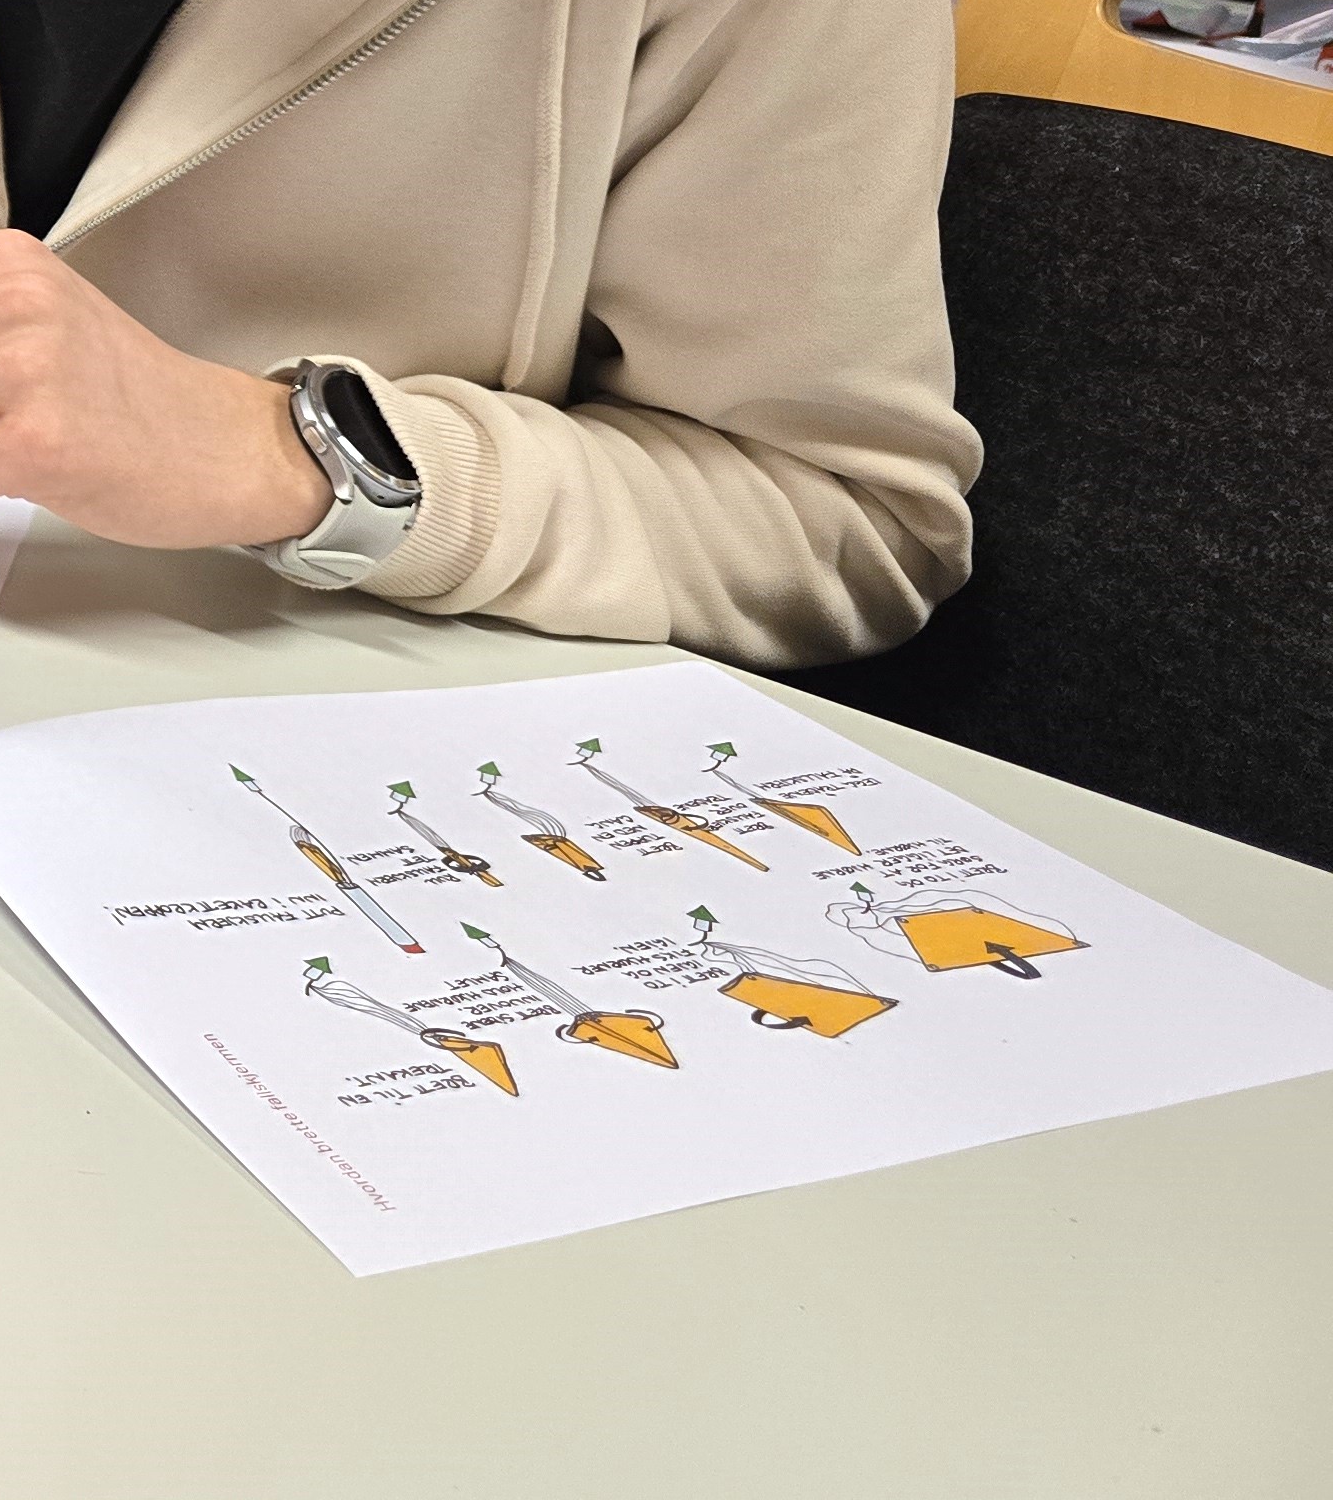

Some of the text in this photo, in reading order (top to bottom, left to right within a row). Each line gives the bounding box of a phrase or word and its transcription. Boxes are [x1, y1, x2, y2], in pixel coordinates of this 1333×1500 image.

[708, 802, 748, 816] OVER
[879, 868, 903, 879] AT
[905, 862, 942, 874] FOR
[288, 893, 327, 906] INN
[301, 905, 345, 920] PUTT
[621, 969, 653, 979] OG
[481, 983, 525, 997] HOLD
[643, 979, 673, 990] TO
[345, 1063, 453, 1088] TREKANT.
[412, 1074, 476, 1095] BRETT
[337, 1094, 373, 1107] EN
[203, 1033, 397, 1212] Hvordan brette fallskjermen
